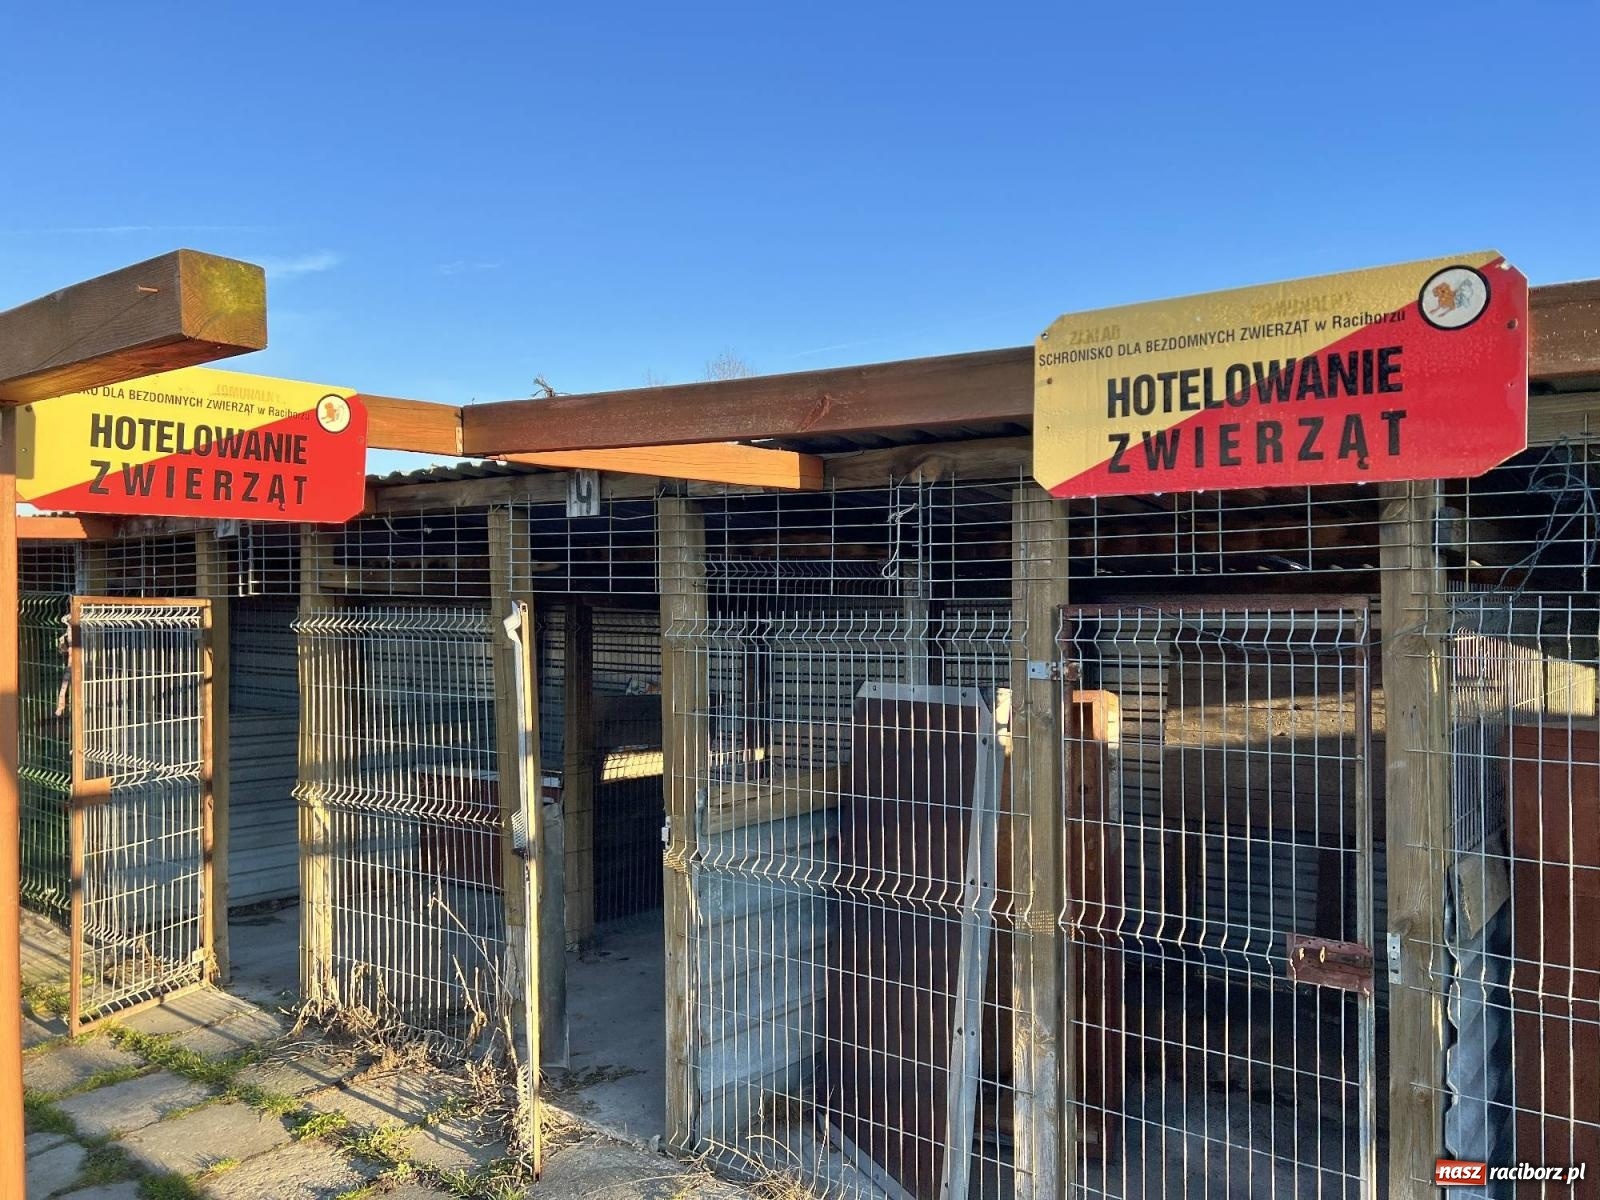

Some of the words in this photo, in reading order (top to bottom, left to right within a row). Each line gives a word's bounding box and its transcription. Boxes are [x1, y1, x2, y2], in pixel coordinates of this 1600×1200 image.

[1039, 345, 1113, 367] SCHRONISKO
[1118, 342, 1142, 357] DLA
[1146, 329, 1235, 353] BEZDOMNYCH
[1240, 319, 1310, 341] ZWIERZĄT
[1315, 320, 1327, 331] w
[1332, 311, 1406, 329] Raciborzu
[103, 387, 125, 399] DLA
[129, 389, 203, 408] BEZDOMNYCH
[206, 399, 255, 416] ZWIERZĄT
[257, 407, 265, 415] w
[1107, 346, 1404, 418] HOTELOWANIE
[90, 412, 308, 464] HOTELOWANIE
[1107, 410, 1407, 474] ZWIERZĄT
[88, 460, 308, 512] ZWIERZĄT
[576, 471, 592, 515] 4
